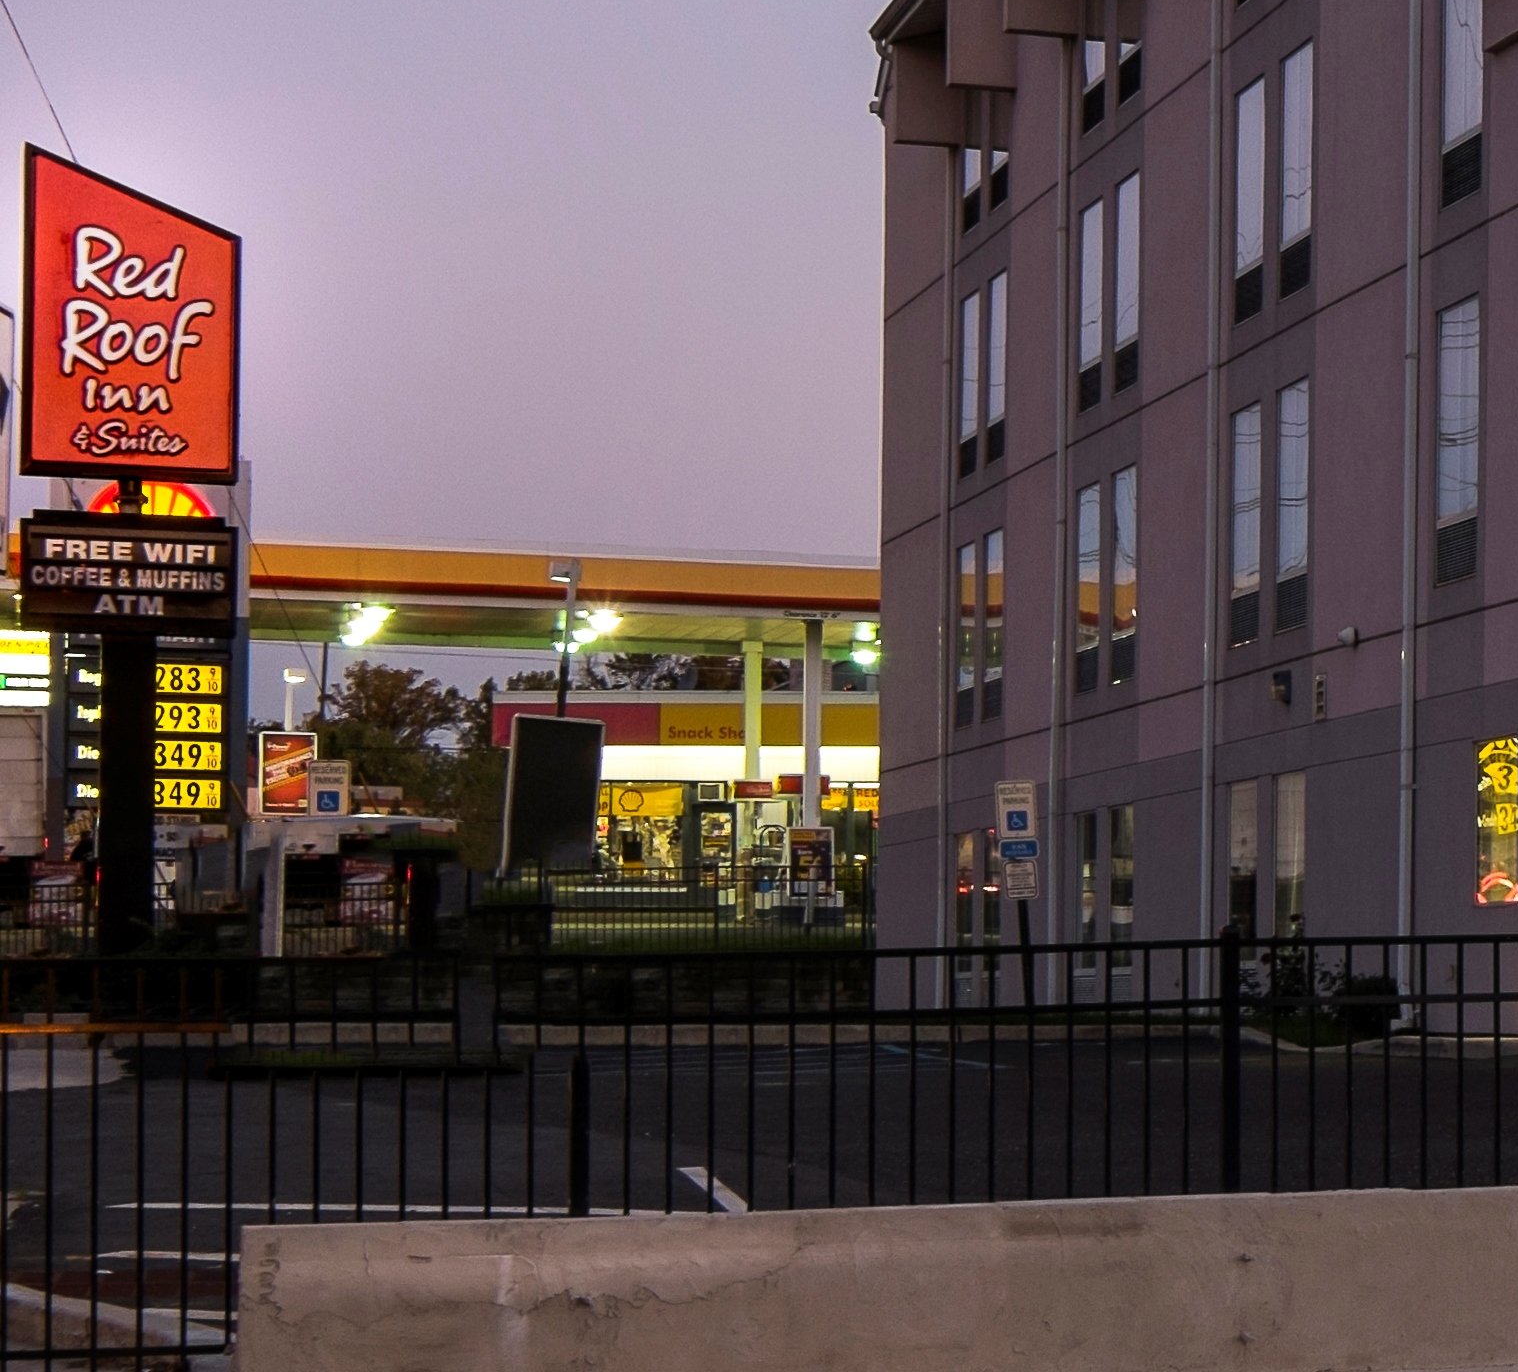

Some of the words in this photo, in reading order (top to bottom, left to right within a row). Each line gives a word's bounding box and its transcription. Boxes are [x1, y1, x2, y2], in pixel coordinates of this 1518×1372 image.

[75, 227, 185, 299] Red
[61, 299, 214, 380] Roof
[84, 378, 172, 412] Inn
[44, 538, 134, 561] FREE
[143, 542, 216, 565] WIFI
[31, 565, 112, 587] COFFEE
[118, 568, 131, 588] &
[94, 594, 164, 616] ATM
[156, 666, 201, 691] 283
[156, 705, 201, 730] 293
[668, 726, 713, 740] Snack
[718, 726, 745, 740] Sho
[155, 743, 202, 768] 349
